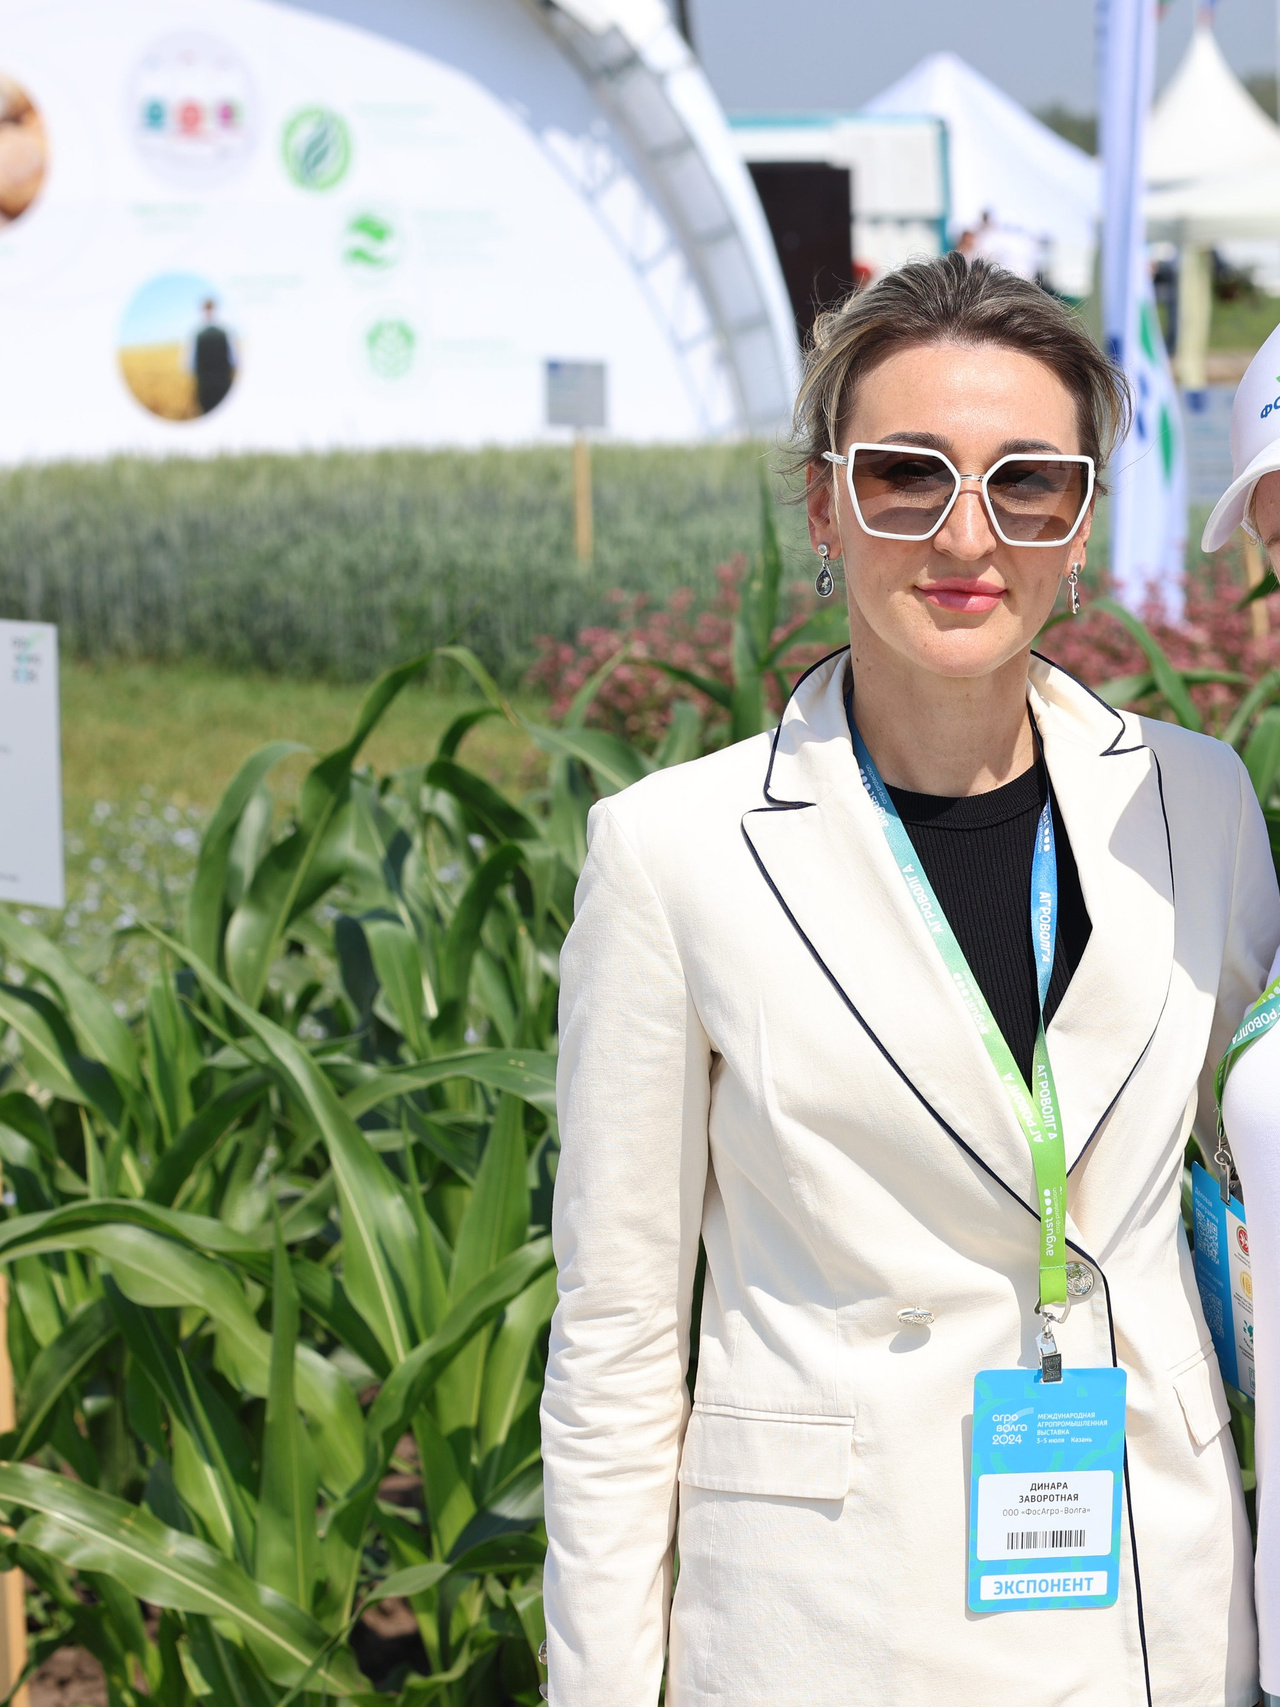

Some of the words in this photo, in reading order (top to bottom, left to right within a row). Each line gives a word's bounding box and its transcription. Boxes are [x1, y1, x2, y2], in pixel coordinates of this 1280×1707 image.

[902, 863, 944, 933] АГРОВОЛГА
[1039, 891, 1051, 963] АГРОВОЛГА
[1003, 1072, 1044, 1143] АГРОВОЛГА
[1037, 1064, 1058, 1140] АГРОВОЛГА
[1052, 1187, 1060, 1219] protection
[1045, 1217, 1057, 1257] avgust
[991, 1413, 1019, 1424] агро
[1037, 1412, 1096, 1420] МЕЖДУНАРОДНАЯ
[996, 1423, 1028, 1433] волга
[1037, 1419, 1108, 1428] АГРОПРОМЫШЛЕННАЯ
[1036, 1428, 1070, 1436] ВЫСТАВКА
[991, 1434, 1023, 1445] 2024
[1029, 1482, 1069, 1492] ДИНАРА
[1018, 1493, 1079, 1504] ЗАВОРОТНАЯ
[1002, 1508, 1020, 1517] ООО
[993, 1577, 1094, 1595] ЭКСПОНЕНТ
